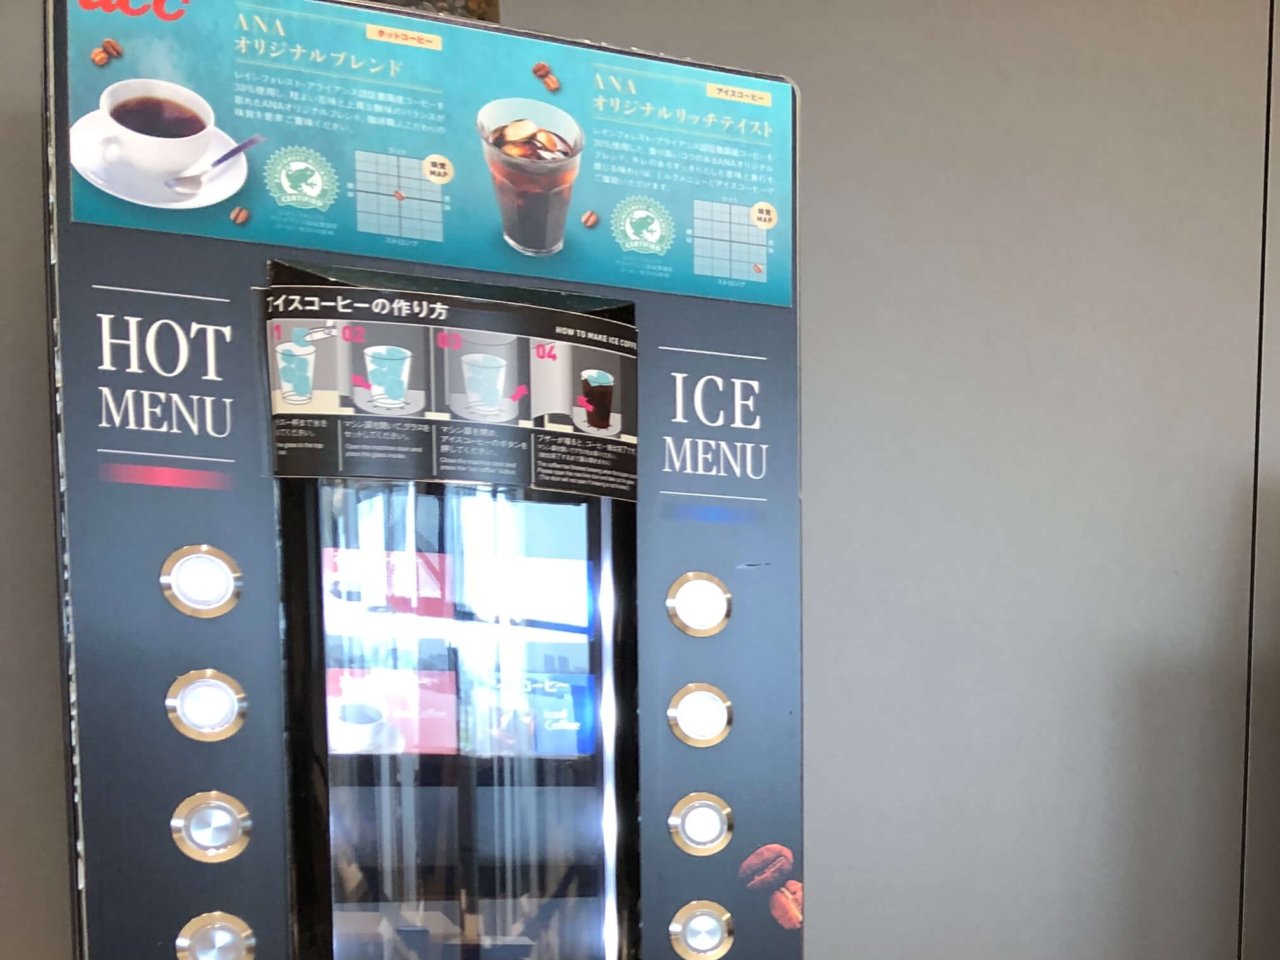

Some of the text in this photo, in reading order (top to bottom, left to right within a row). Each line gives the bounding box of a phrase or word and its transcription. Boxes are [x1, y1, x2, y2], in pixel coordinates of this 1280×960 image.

[234, 36, 403, 78] オリジナルブレンド
[716, 87, 765, 102] アイスコーヒー
[593, 95, 773, 138] オリジナルリッチテイスト
[96, 313, 232, 381] HOT
[342, 325, 366, 343] 02
[535, 344, 557, 361] 04
[555, 325, 575, 336] HOW
[576, 329, 587, 338] TO
[587, 332, 608, 343] MAKE
[608, 336, 619, 345] ICE
[98, 386, 235, 438] MENU
[671, 372, 761, 430] ICE
[662, 436, 769, 480] MENU
